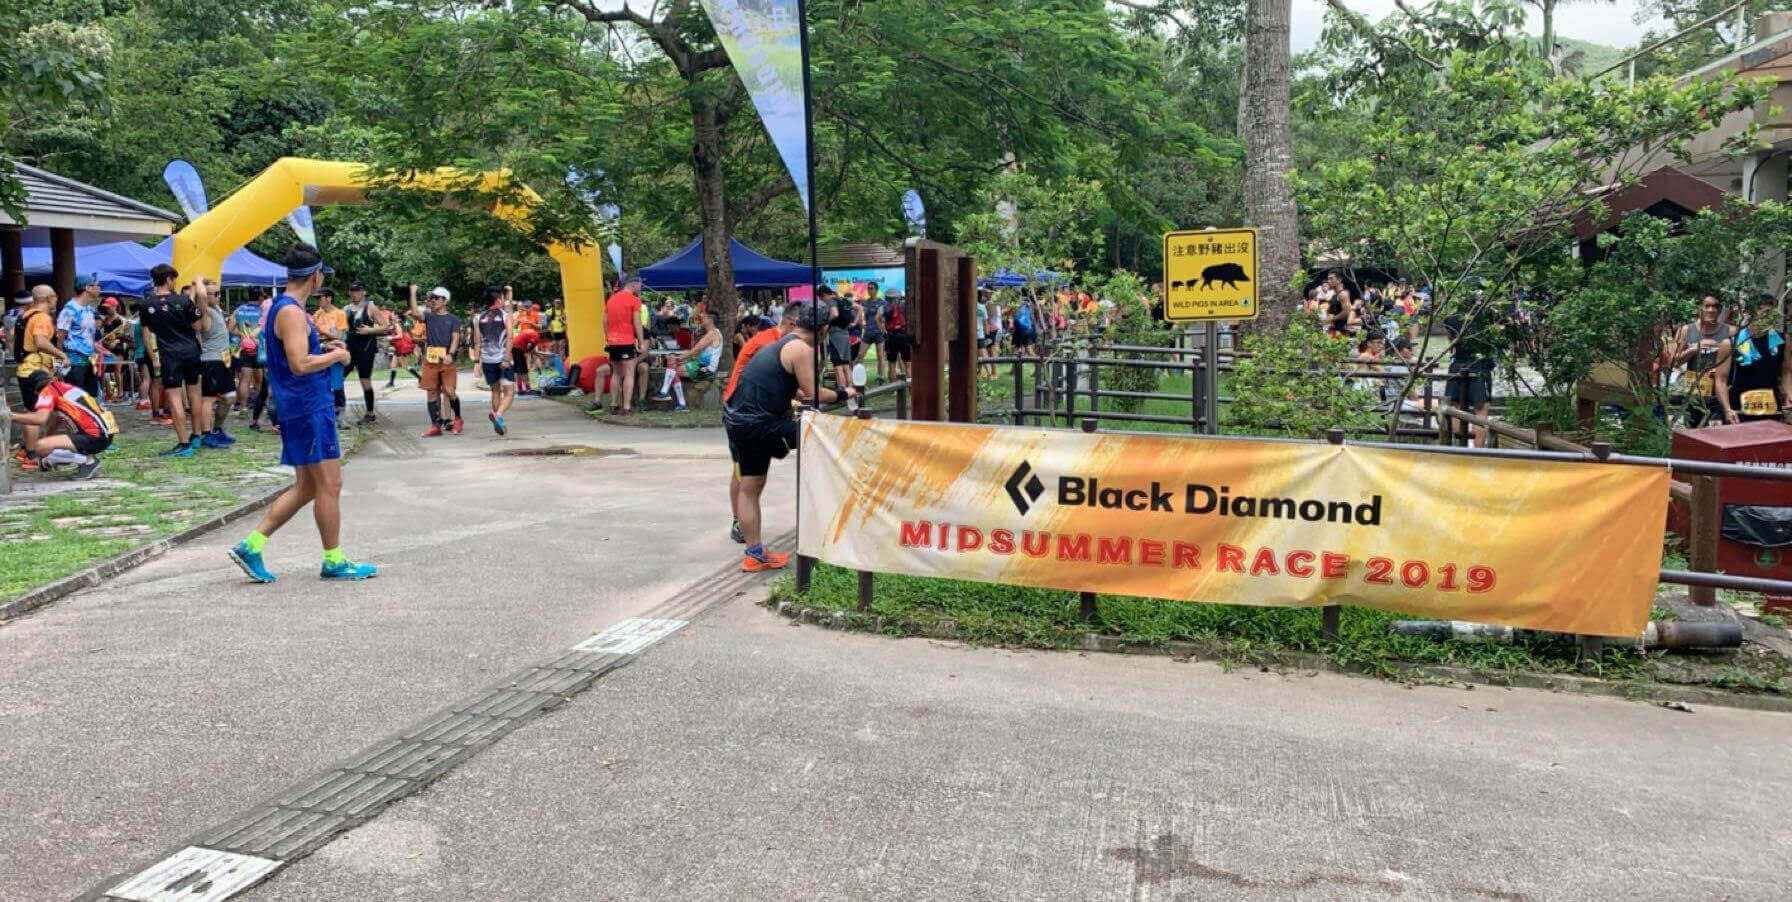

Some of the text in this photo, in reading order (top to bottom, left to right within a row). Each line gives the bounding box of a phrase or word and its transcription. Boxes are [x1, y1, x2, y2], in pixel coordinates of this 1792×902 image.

[1172, 300, 1191, 308] WILD
[1192, 299, 1208, 308] PIGS
[1218, 299, 1239, 308] AREA
[1059, 476, 1382, 526] Black Diamond
[899, 520, 1497, 594] MIDSUMMER RACE 2019
